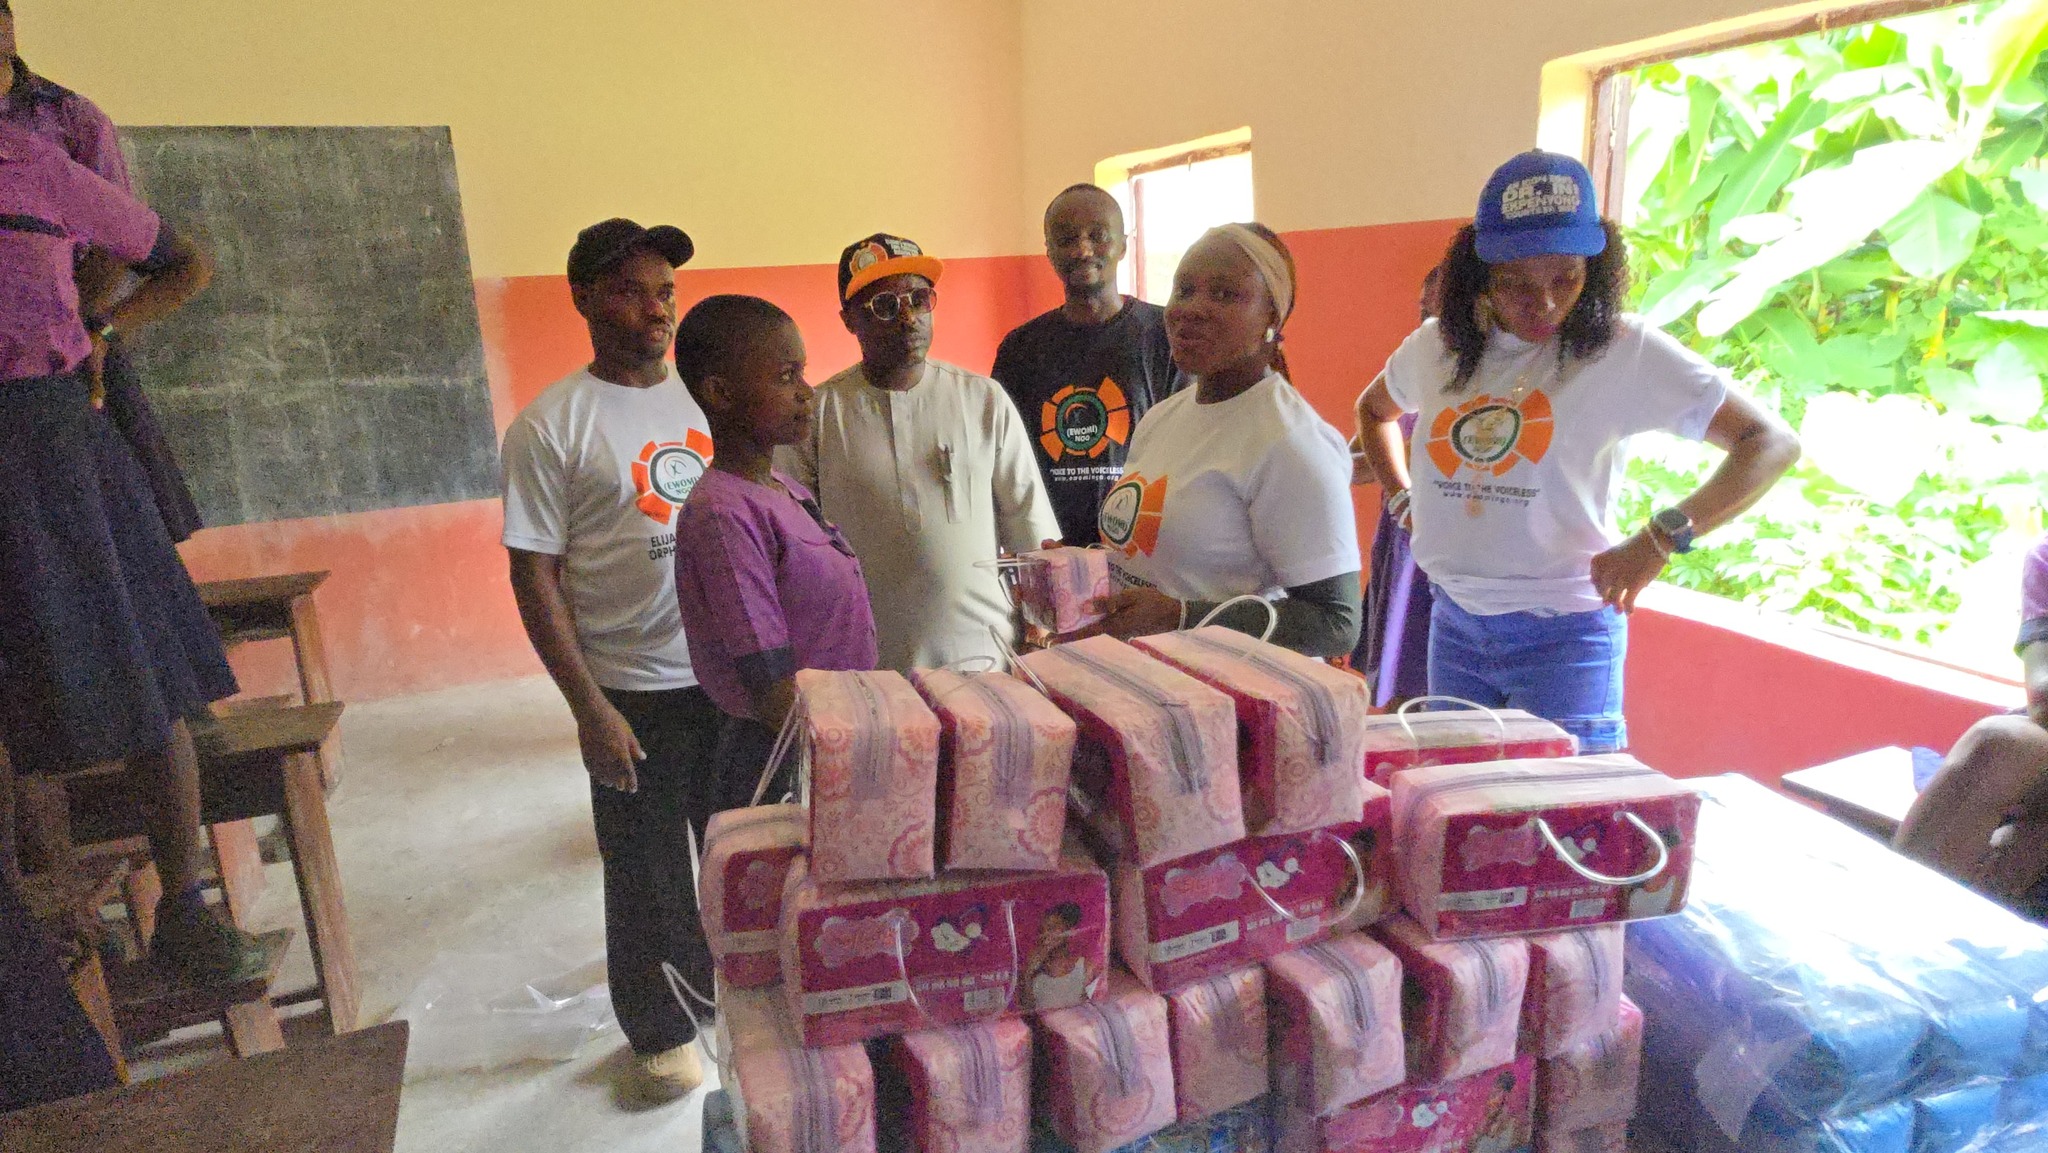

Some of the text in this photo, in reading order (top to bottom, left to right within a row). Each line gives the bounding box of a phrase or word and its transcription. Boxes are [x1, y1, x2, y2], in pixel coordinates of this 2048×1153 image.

[1067, 467, 1076, 475] TO
[1077, 466, 1090, 474] THE
[651, 533, 677, 548] ELIJA
[649, 546, 677, 560] ORPH
